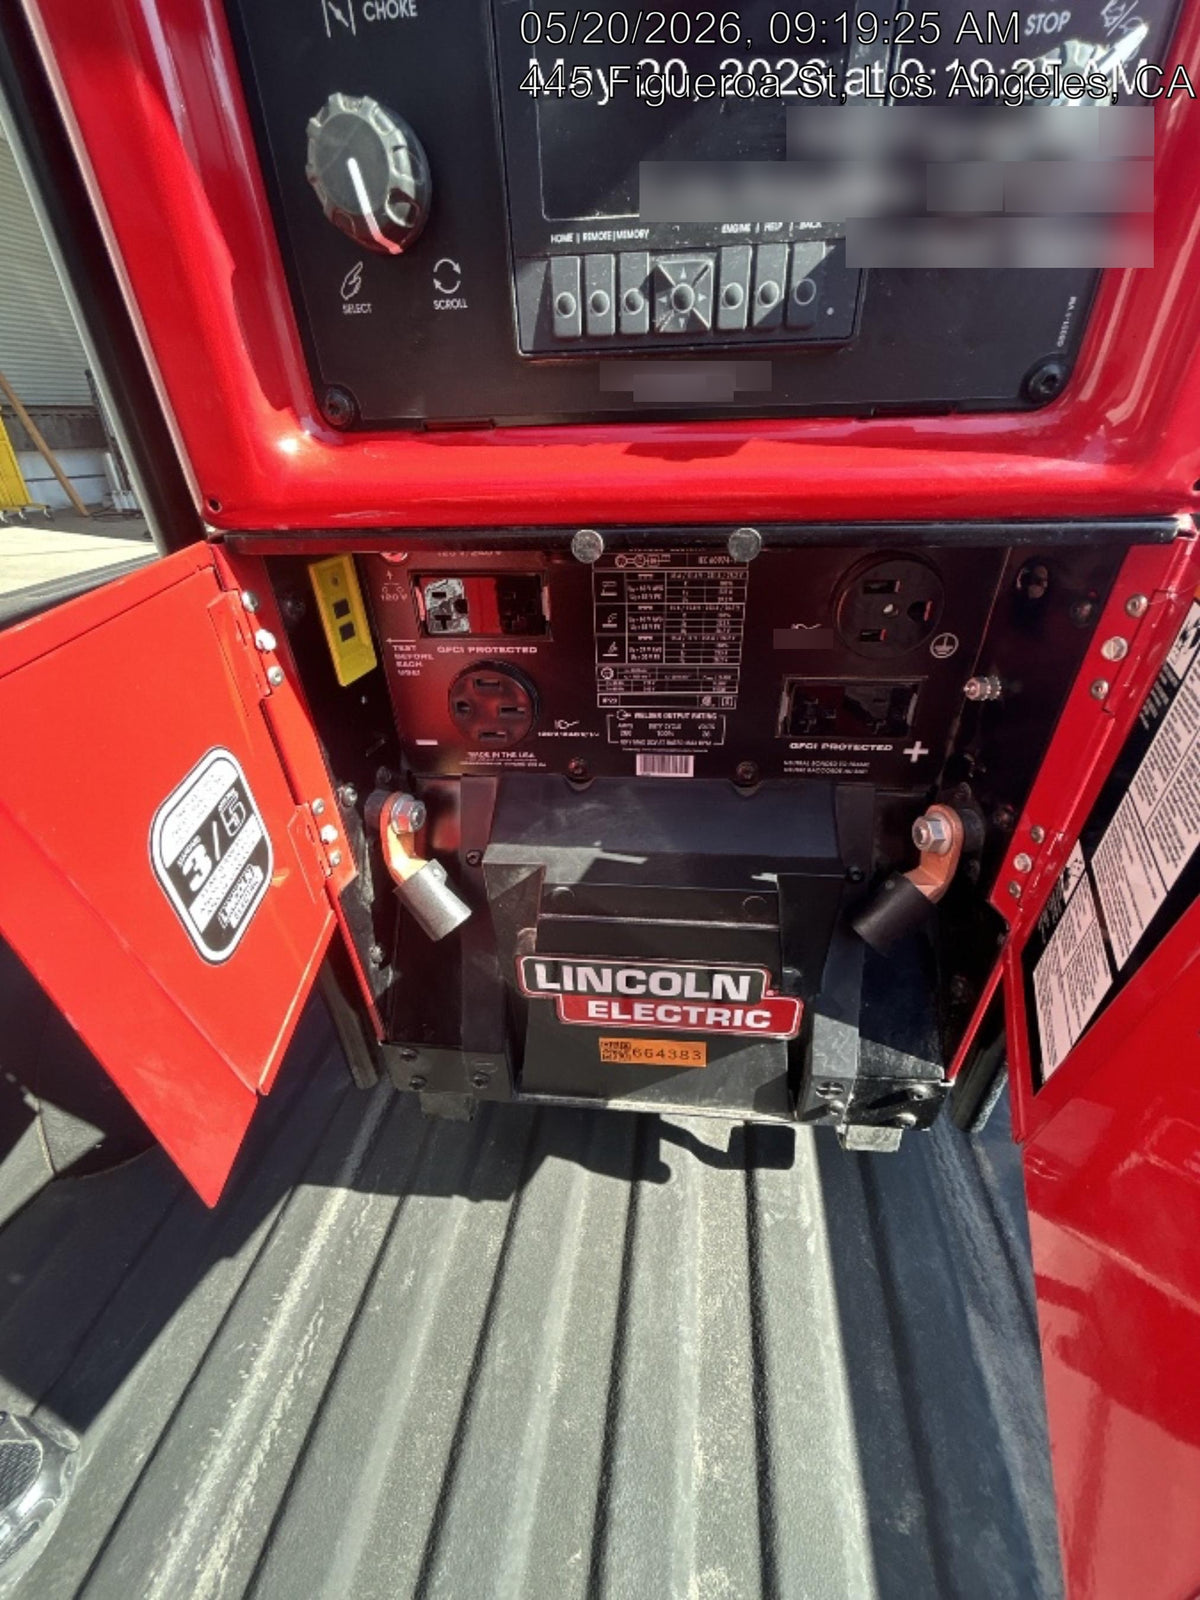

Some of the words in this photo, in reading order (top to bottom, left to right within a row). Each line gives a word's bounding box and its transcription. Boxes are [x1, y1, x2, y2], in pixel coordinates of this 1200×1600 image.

[363, 0, 418, 21] CHOKE
[1024, 10, 1071, 35] STOP
[550, 232, 574, 244] HOME
[616, 228, 650, 241] MEMORY
[342, 303, 373, 315] SELECT
[433, 298, 469, 311] SCROLL
[437, 646, 465, 654] GFCI
[468, 646, 538, 654] PROTECTED
[789, 742, 817, 750] GFCI
[821, 742, 893, 752] PROTECTED
[534, 963, 751, 1001] LINCOLN
[587, 1000, 772, 1028] ELECTRIC
